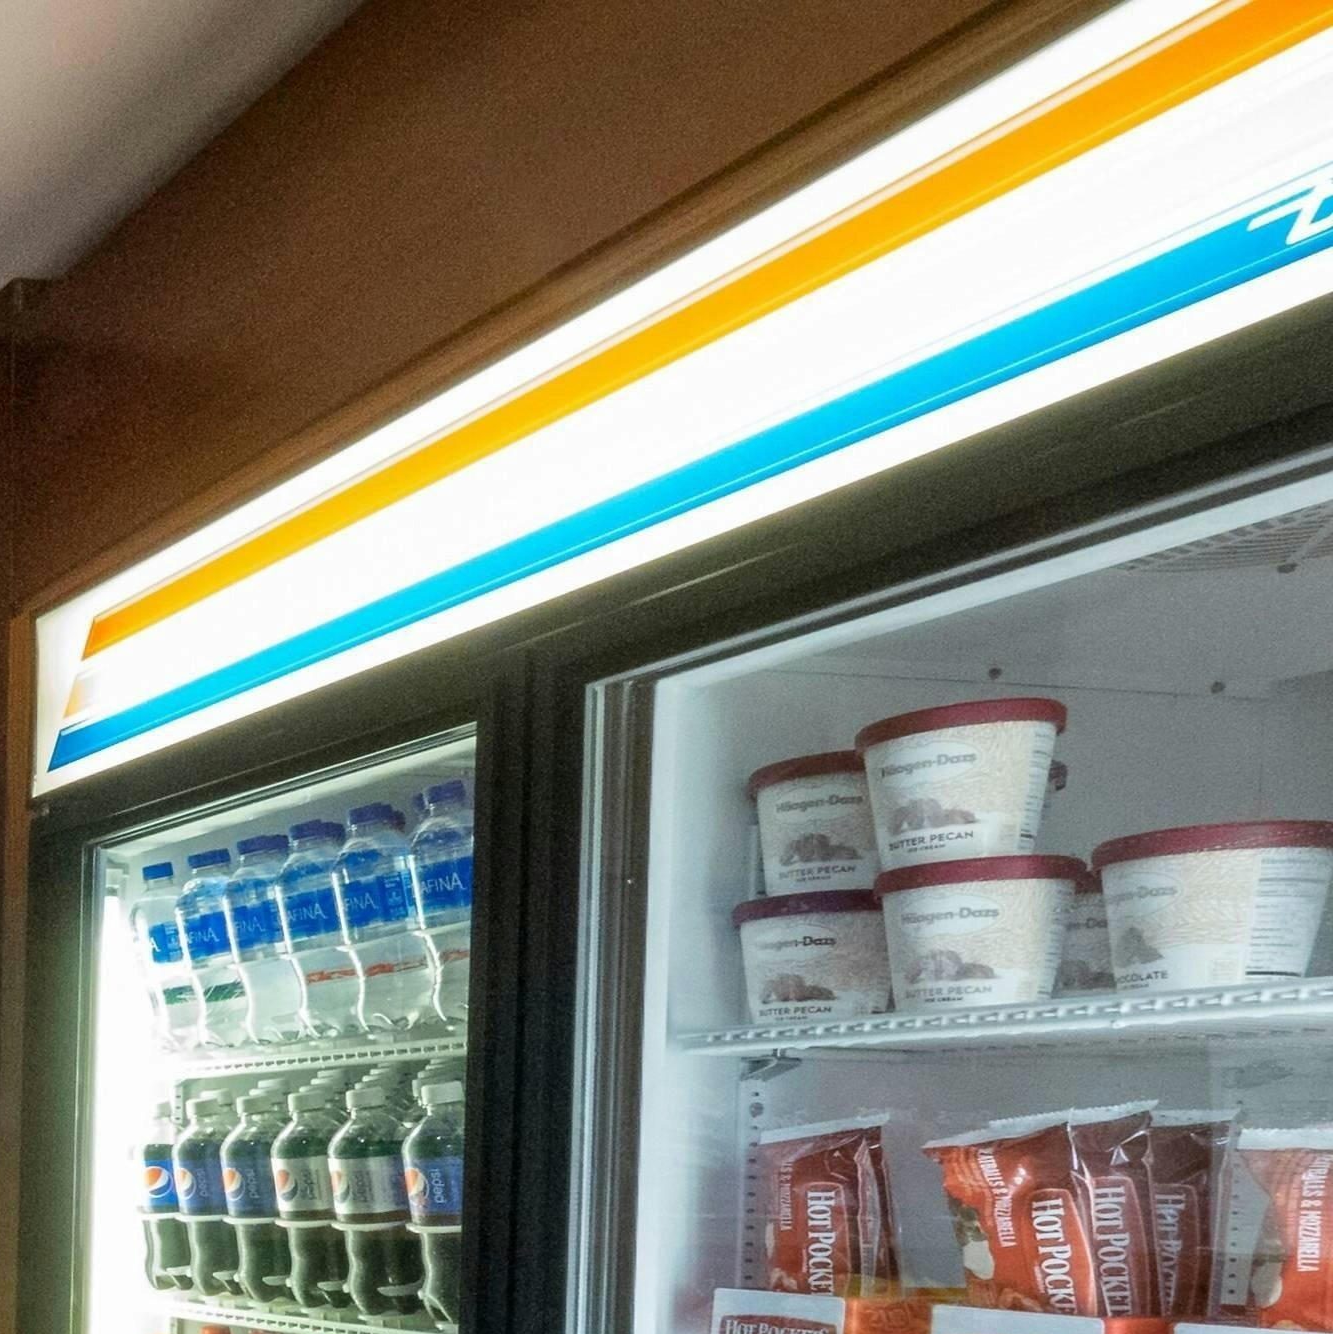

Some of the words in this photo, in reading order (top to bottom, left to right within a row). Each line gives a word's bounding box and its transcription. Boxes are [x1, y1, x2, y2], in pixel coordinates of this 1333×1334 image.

[889, 837, 925, 851] BUTTER
[929, 830, 975, 843] PECAN
[779, 867, 814, 879] BUTTER
[816, 865, 857, 875] PECAN
[905, 987, 944, 999] BUTTER
[947, 984, 993, 995] PECAN
[759, 1006, 791, 1017] BUTTER
[793, 1005, 833, 1015] PECAN
[247, 1168, 261, 1199] pepsi
[431, 1168, 446, 1205] pepsi
[807, 1190, 837, 1230] HOT
[994, 1194, 1017, 1248] MOZZARELLA
[1032, 1198, 1065, 1242] HOT
[1094, 1186, 1126, 1234] HOT
[1304, 1199, 1321, 1209] &
[1297, 1210, 1322, 1272] MOZZARELLA
[807, 1231, 837, 1296] POCKE
[1038, 1244, 1077, 1314] POCKE
